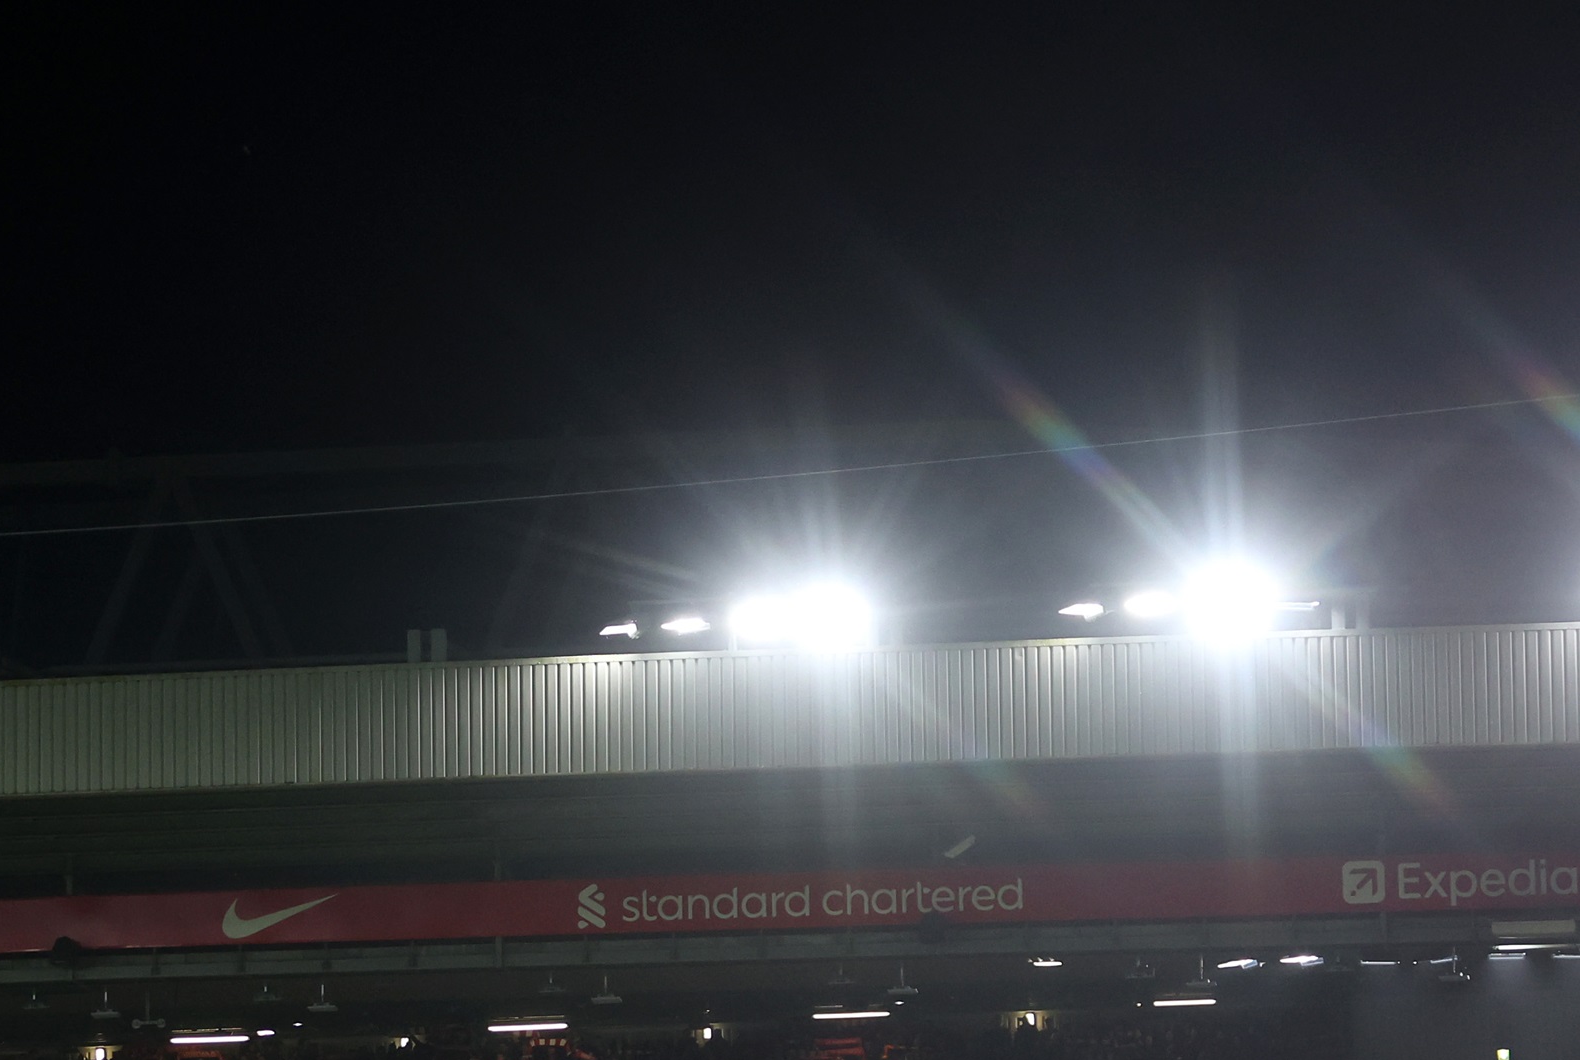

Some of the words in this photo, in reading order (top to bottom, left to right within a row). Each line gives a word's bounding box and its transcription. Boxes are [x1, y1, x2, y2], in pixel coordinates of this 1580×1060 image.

[622, 885, 810, 923] standard
[822, 879, 1024, 917] chartered
[1398, 858, 1578, 906] Expedia
